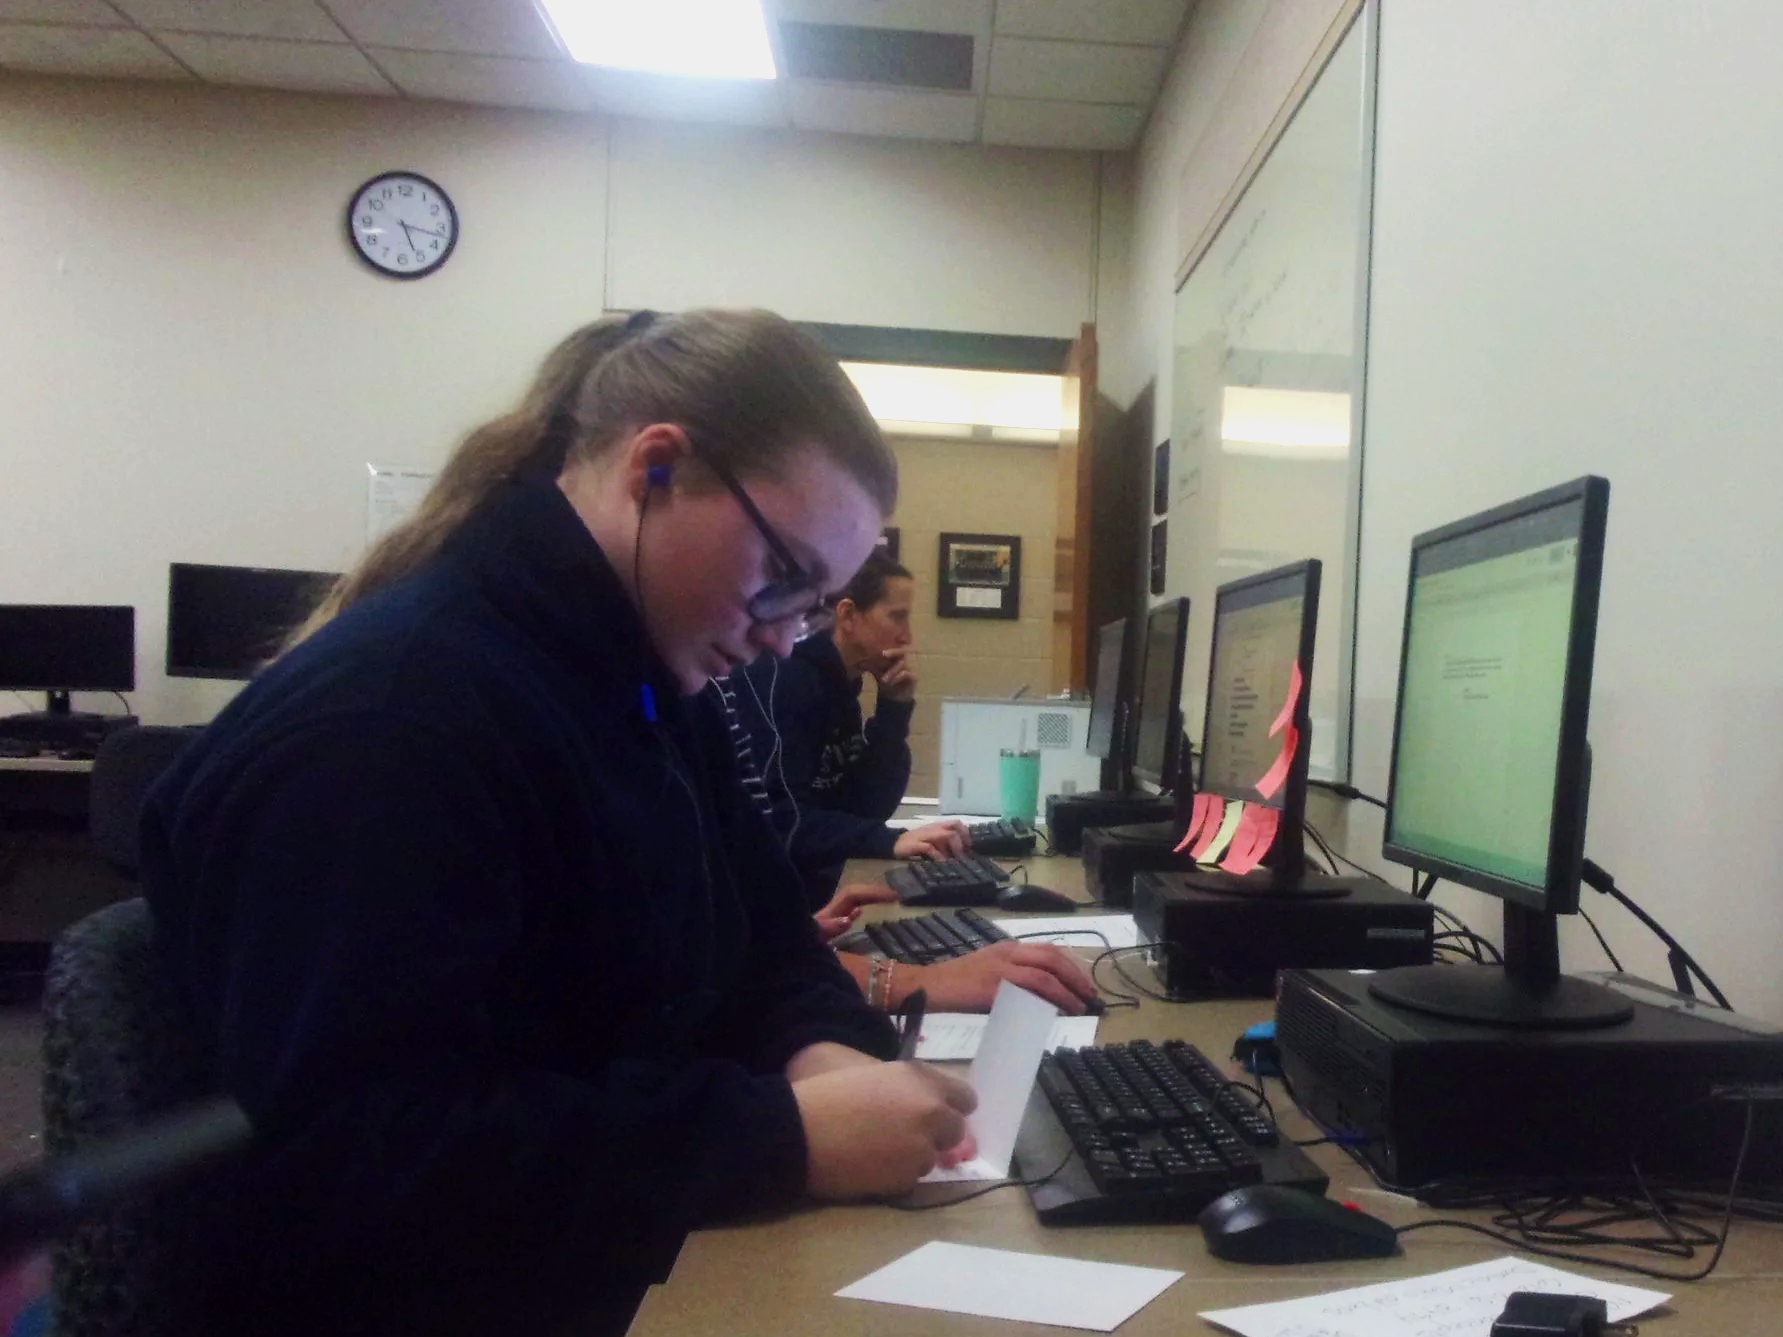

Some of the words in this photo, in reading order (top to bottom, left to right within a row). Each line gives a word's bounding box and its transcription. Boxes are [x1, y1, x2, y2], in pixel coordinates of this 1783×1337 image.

[382, 188, 393, 201] 11
[397, 185, 413, 197] 12
[422, 191, 426, 202] 1
[368, 199, 384, 211] 10
[430, 204, 440, 216] 2
[362, 215, 373, 227] 9
[436, 222, 446, 233] 3
[366, 234, 377, 245] 8
[429, 239, 438, 250] 4
[382, 246, 390, 257] 7
[416, 249, 425, 263] 5
[397, 253, 408, 265] 6
